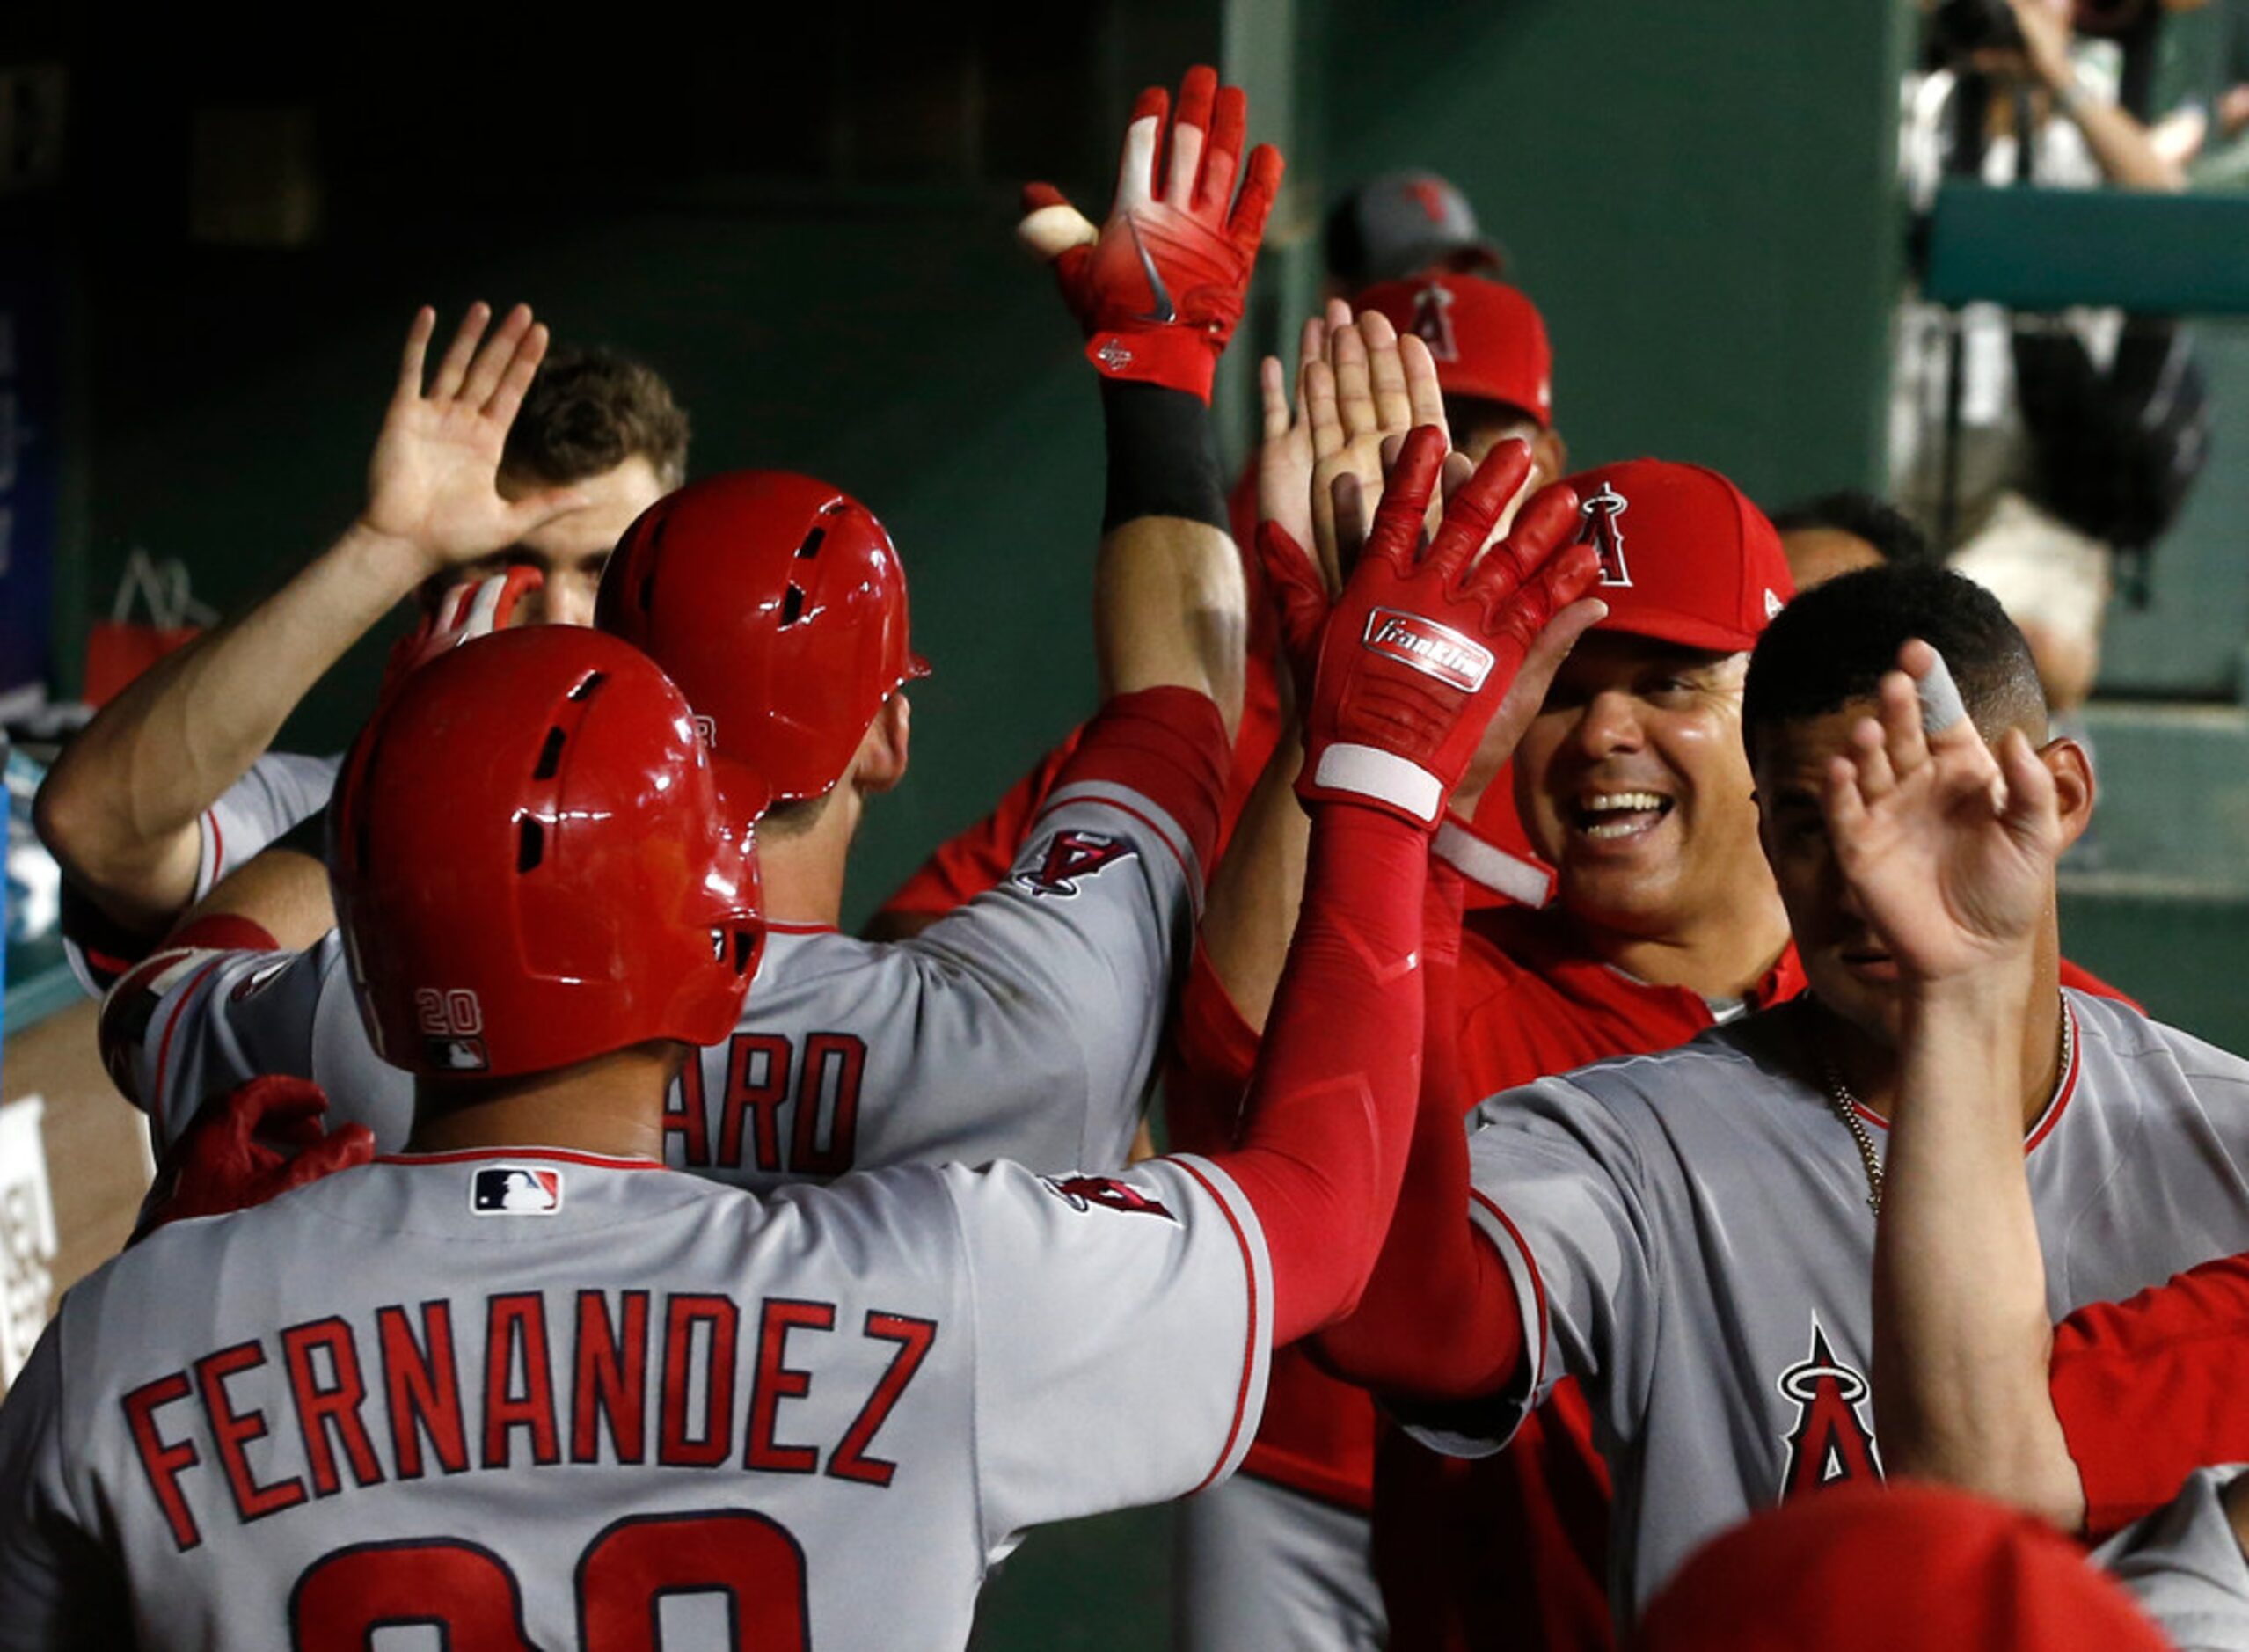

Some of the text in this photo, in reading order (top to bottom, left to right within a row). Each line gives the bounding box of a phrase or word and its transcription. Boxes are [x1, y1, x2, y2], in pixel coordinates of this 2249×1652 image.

[415, 987, 483, 1036] 20
[120, 1289, 938, 1553] FERNANDEZ
[1777, 1307, 1890, 1507] A
